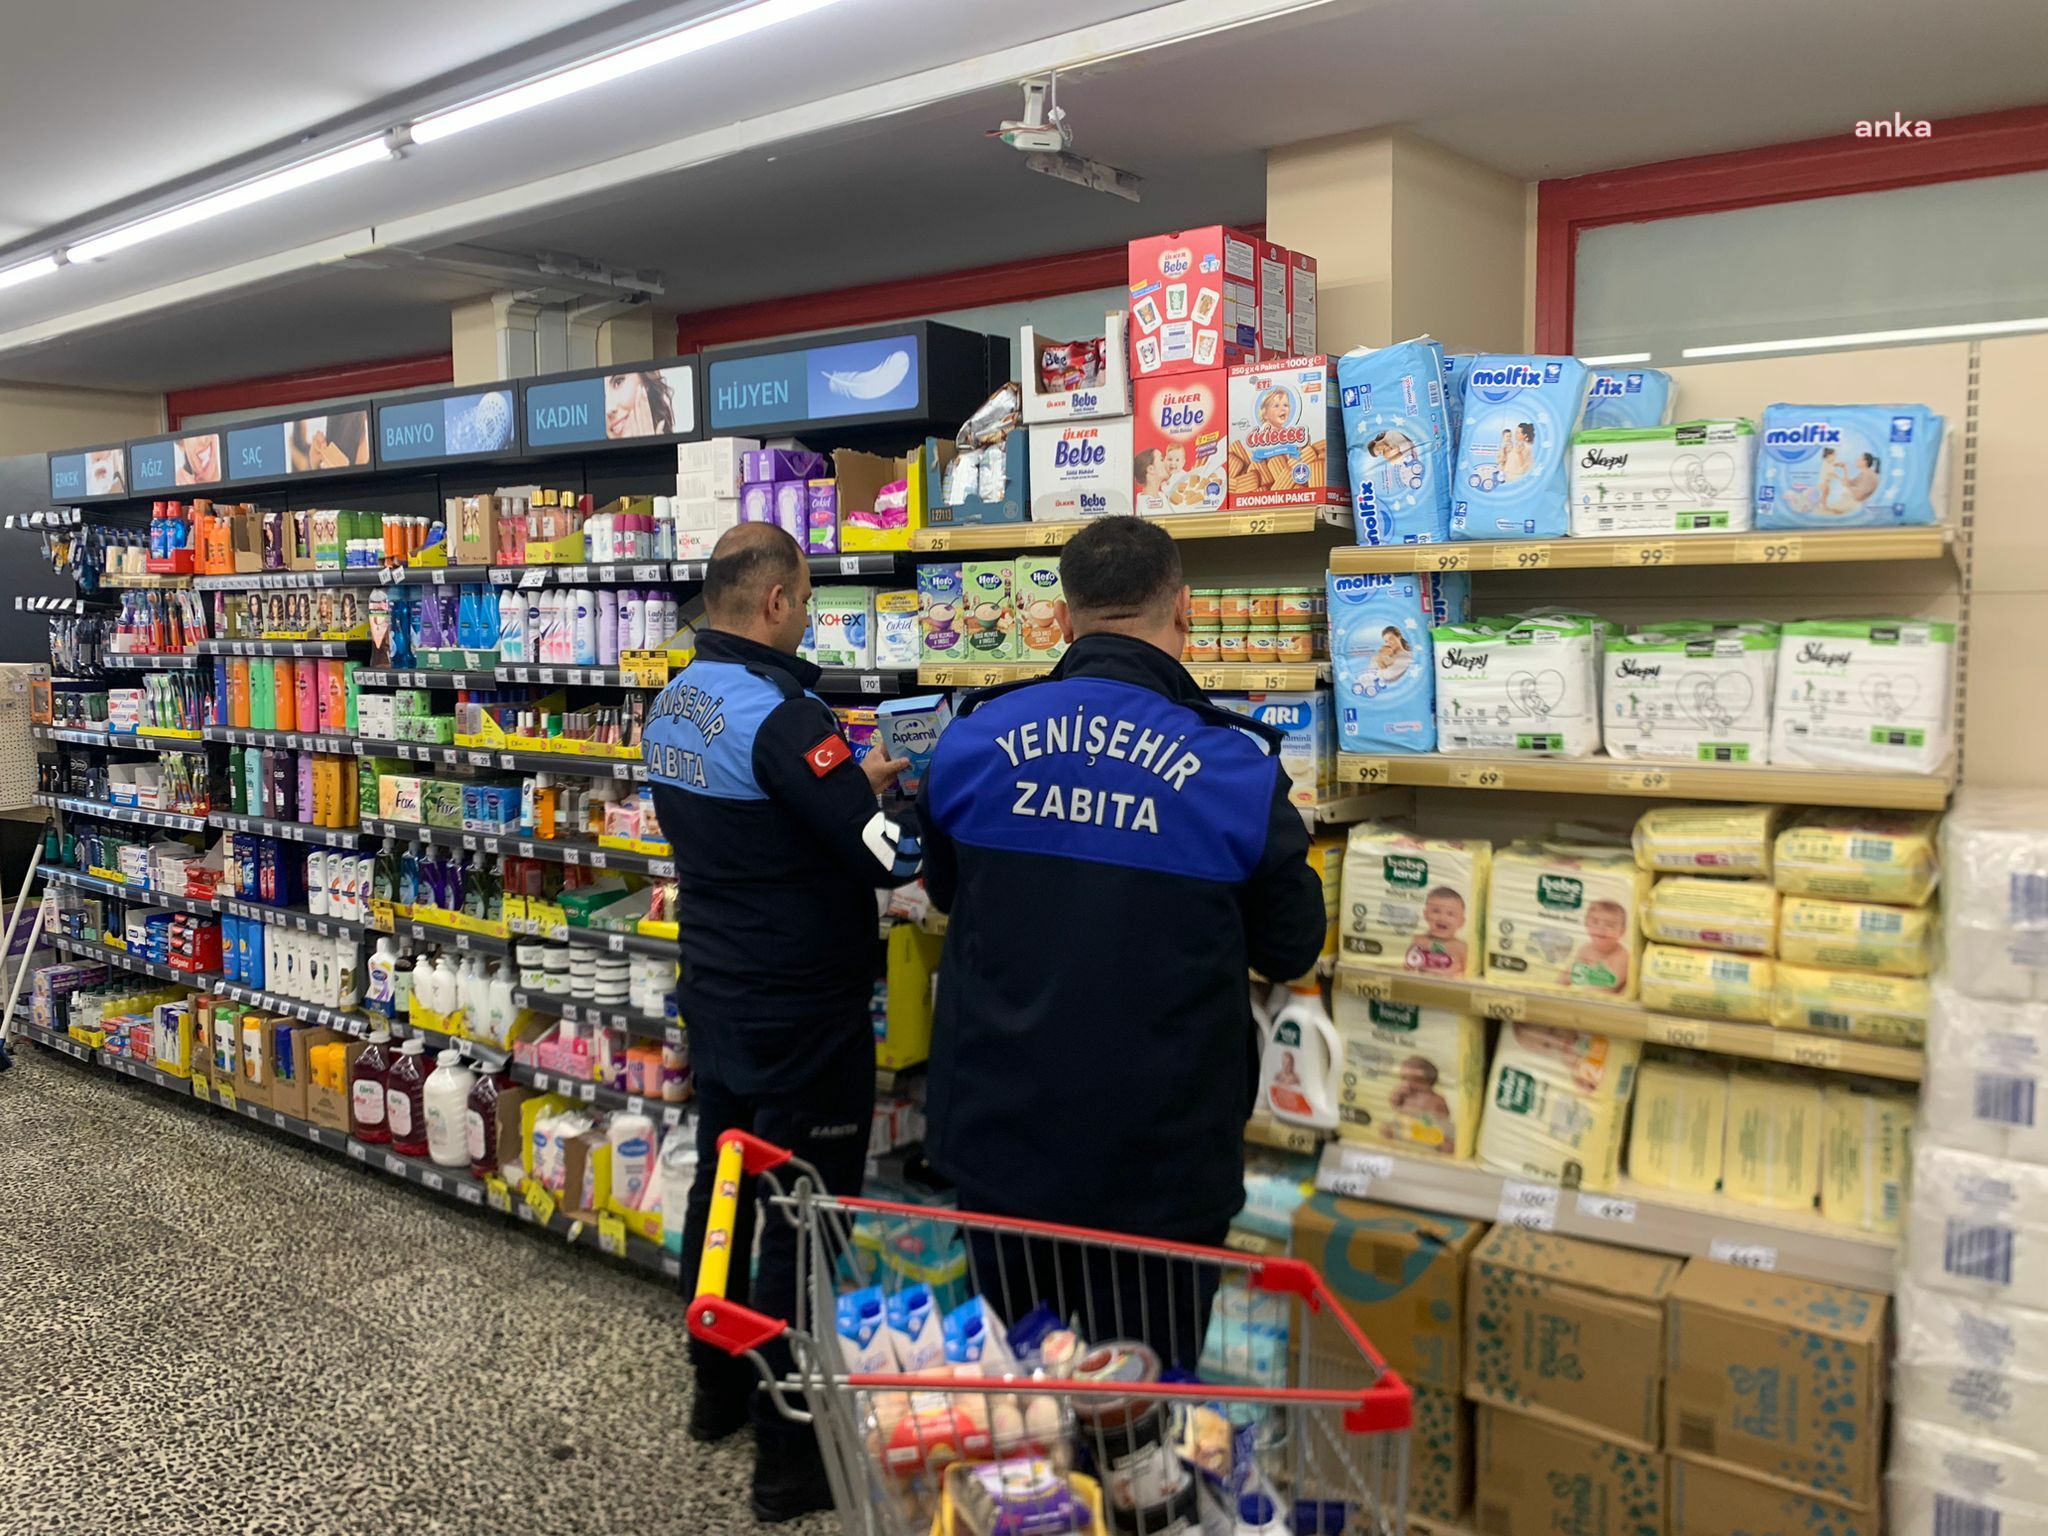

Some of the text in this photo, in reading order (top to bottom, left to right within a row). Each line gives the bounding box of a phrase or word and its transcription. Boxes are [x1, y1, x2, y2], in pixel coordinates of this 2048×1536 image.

[1163, 259, 1188, 274] Bebe
[1286, 358, 1307, 368] 1000
[1472, 365, 1542, 388] molfix
[718, 379, 789, 411] HİJYEN
[1072, 392, 1098, 408] Bebe
[1163, 393, 1201, 405] ÜLKER
[535, 404, 589, 429] KADIN
[1161, 405, 1204, 428] Bebe
[386, 423, 435, 448] BANYO
[1063, 428, 1098, 441] ÜLKER
[1766, 424, 1841, 444] molfix
[242, 446, 263, 470] SAÇ
[1054, 438, 1106, 469] Bebe
[1581, 448, 1629, 470] Sleepy
[140, 459, 163, 477] AĞIZ
[55, 471, 79, 488] ERKEK
[1080, 493, 1106, 508] Bebe
[1236, 492, 1285, 507] EKONOMİK
[1287, 492, 1317, 504] PAKET
[1250, 521, 1266, 533] 92
[931, 538, 943, 550] 25
[1518, 553, 1539, 567] 99
[1640, 550, 1662, 564] 99
[1763, 545, 1788, 562] 99
[1439, 556, 1459, 569] 99
[932, 576, 953, 586] Hero
[979, 575, 1000, 586] Hero
[1033, 572, 1055, 582] Hero
[1336, 573, 1393, 592] molfix
[1432, 572, 1447, 628] molfi
[1441, 647, 1489, 671] Sleepy
[1795, 641, 1853, 667] Sleepy
[1615, 657, 1661, 680] Sleepy
[866, 678, 876, 689] 70
[935, 673, 947, 684] 97
[984, 674, 997, 685] 97
[1203, 676, 1215, 688] 15
[1265, 677, 1277, 689] 15
[647, 683, 725, 748] ENİŞEHİR
[1261, 706, 1300, 726] ARI
[892, 728, 937, 745] Aptamil
[994, 703, 1202, 792] YENİŞEHİR
[1359, 768, 1379, 781] 99
[1479, 773, 1498, 785] 69
[1011, 781, 1159, 834] ZABITA
[1387, 856, 1426, 873] bebe
[1393, 868, 1422, 881] land
[1356, 984, 1381, 998] 100
[1488, 1002, 1514, 1018] 100
[1666, 1028, 1696, 1044] 100
